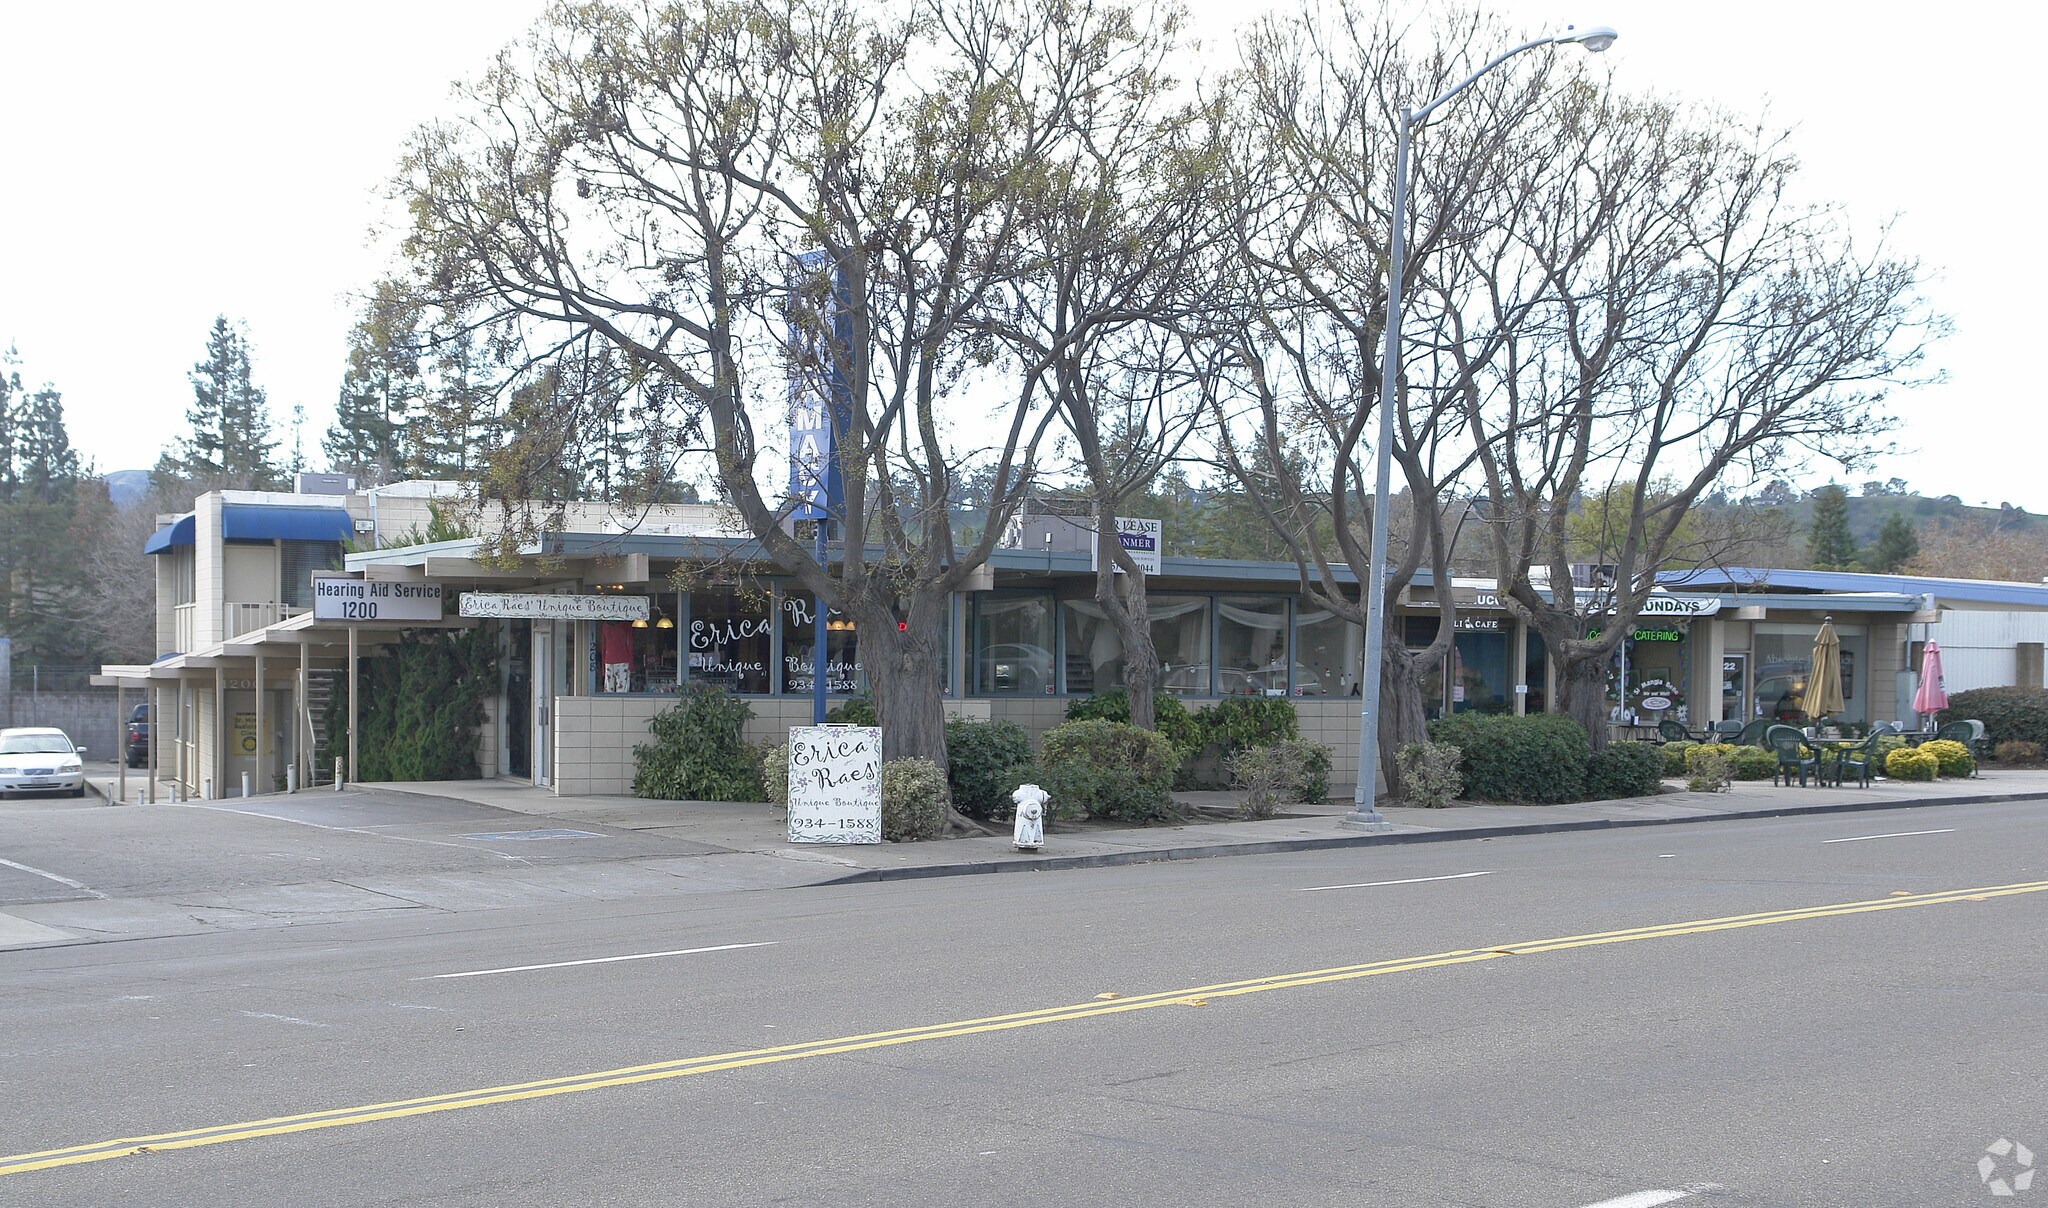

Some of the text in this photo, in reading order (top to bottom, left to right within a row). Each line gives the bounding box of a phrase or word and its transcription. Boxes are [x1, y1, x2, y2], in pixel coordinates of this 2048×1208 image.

[1123, 520, 1157, 532] LEASE
[1119, 538, 1151, 548] NMER
[317, 582, 440, 599] Hearing Aid Service
[342, 602, 377, 618] 1200
[465, 597, 643, 618] Erica Raes' Unique Boutique
[1454, 620, 1498, 628] LI CAFE
[691, 619, 771, 649] Erica
[1634, 630, 1679, 641] CATERING
[701, 656, 864, 679] Unique Bouique
[1724, 662, 1736, 670] 22
[789, 680, 858, 690] 9341588
[794, 742, 868, 766] Erica
[812, 761, 878, 790] Raes'
[793, 797, 880, 811] Unique Boutique
[794, 819, 874, 829] 934-1588
